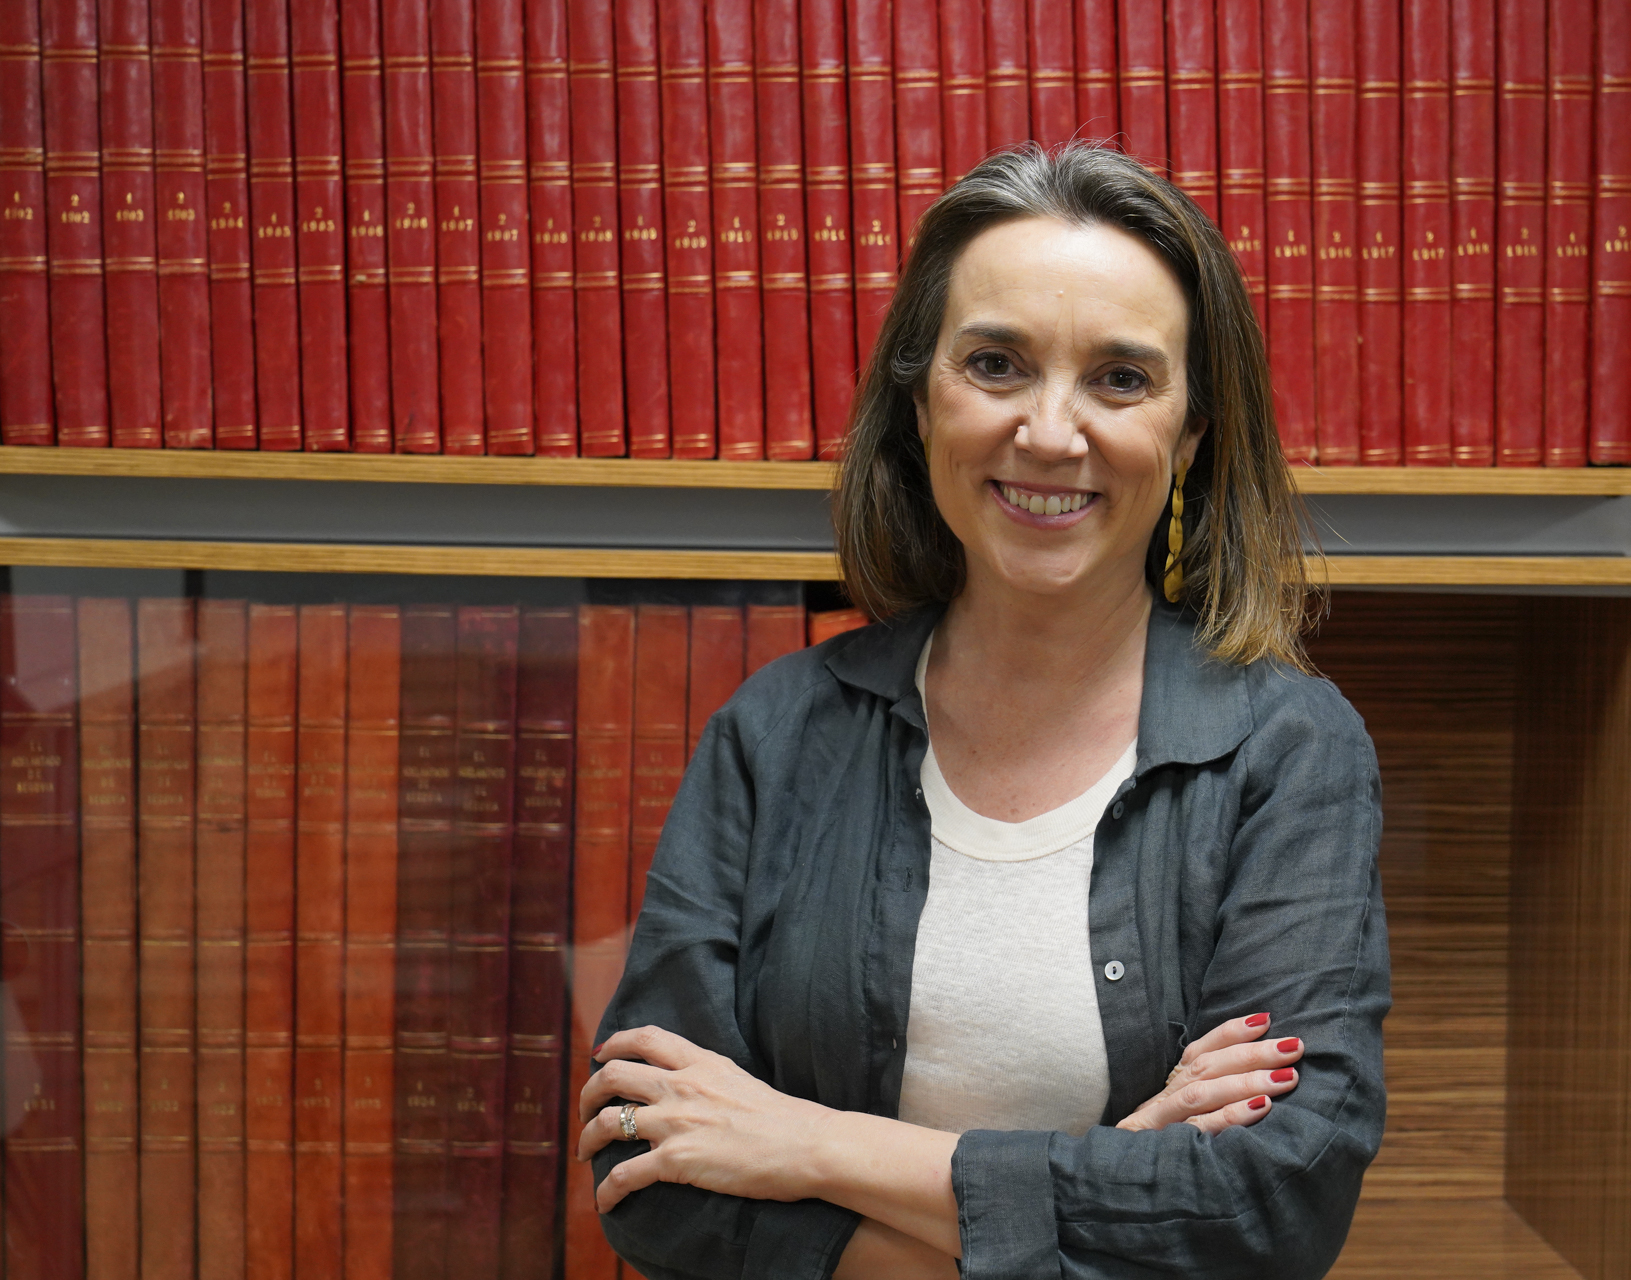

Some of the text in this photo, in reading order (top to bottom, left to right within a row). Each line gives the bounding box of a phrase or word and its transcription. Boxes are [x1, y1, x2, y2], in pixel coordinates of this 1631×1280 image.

[14, 191, 20, 203] 1
[71, 193, 79, 206] 2
[126, 192, 132, 204] 1
[176, 191, 185, 204] 2
[223, 201, 231, 213] 2
[315, 206, 323, 218] 2
[407, 202, 415, 214] 2
[453, 205, 459, 217] 1
[271, 212, 277, 224] 1
[363, 209, 370, 222] 1
[498, 212, 506, 225] 2
[592, 215, 601, 228] 2
[637, 214, 644, 226] 1
[733, 215, 740, 228] 1
[776, 213, 785, 226] 2
[825, 214, 833, 227] 1
[441, 218, 473, 232] 1907
[547, 217, 553, 230] 1
[687, 219, 696, 232] 2
[872, 219, 881, 232] 2
[486, 228, 518, 242] 1907
[1241, 225, 1249, 238] 2
[1287, 228, 1294, 242] 1
[1332, 230, 1341, 243] 2
[1375, 230, 1382, 243] 1
[1425, 230, 1434, 243] 2
[1470, 227, 1477, 239] 1
[1520, 227, 1529, 239] 2
[1618, 224, 1626, 237] 2
[1569, 231, 1576, 244] 1
[1605, 239, 1631, 253] 191
